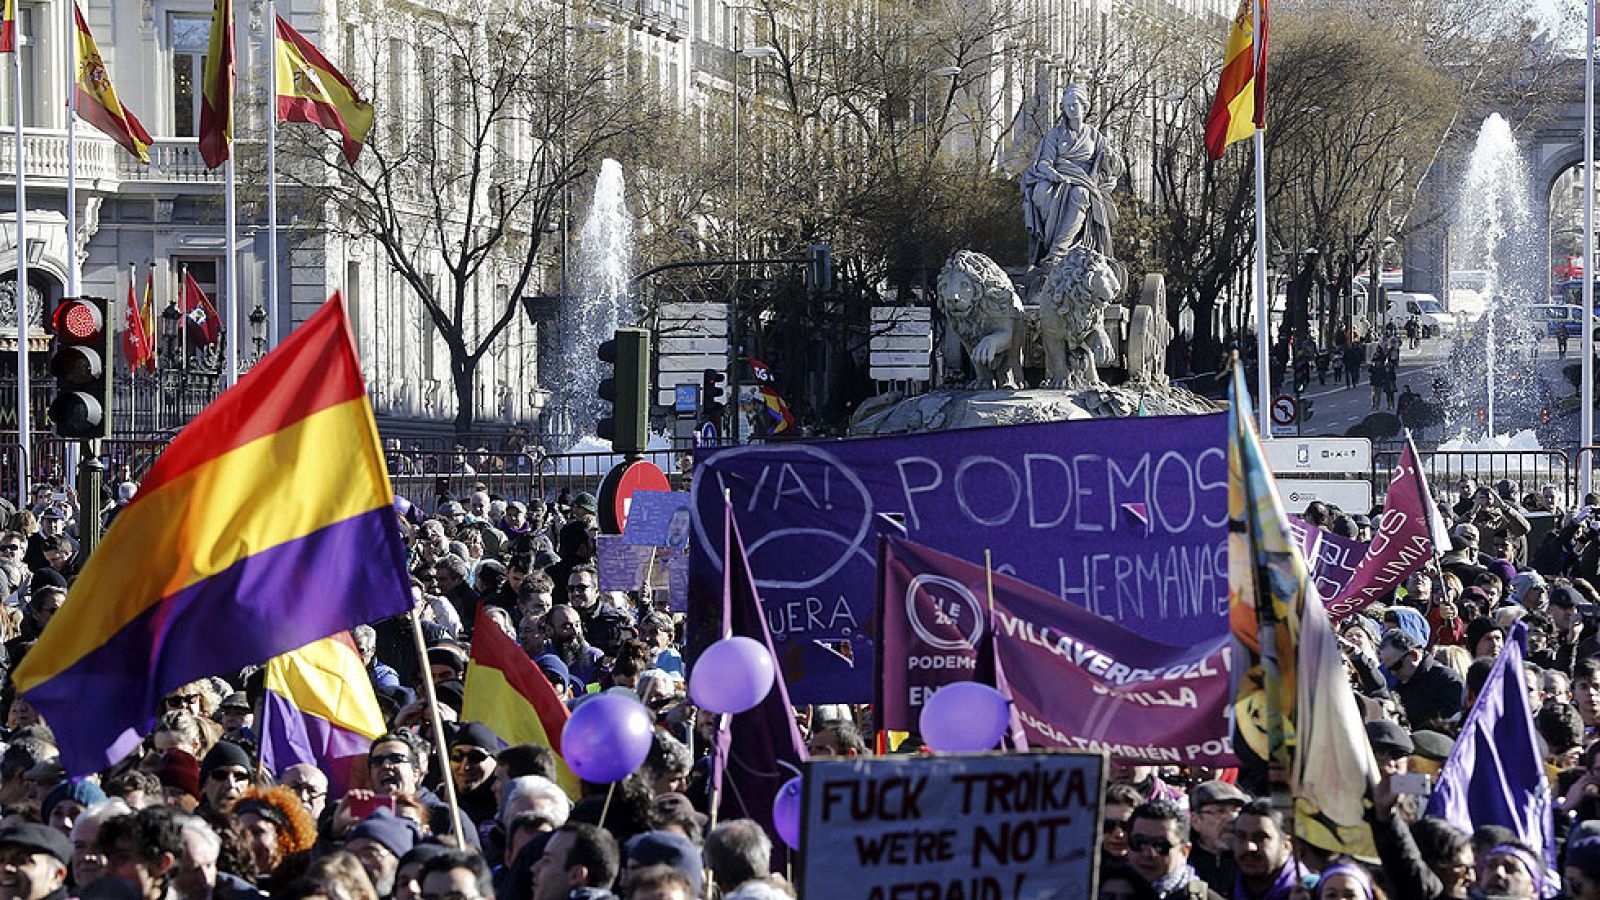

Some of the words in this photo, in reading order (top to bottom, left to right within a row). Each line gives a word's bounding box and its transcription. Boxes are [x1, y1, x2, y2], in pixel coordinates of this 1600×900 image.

[896, 447, 1229, 533] PODEMOS
[1374, 534, 1431, 585] LIMIA
[821, 774, 928, 823] FUCK
[854, 828, 957, 867] WE'RE
[971, 816, 1072, 868] NOT
